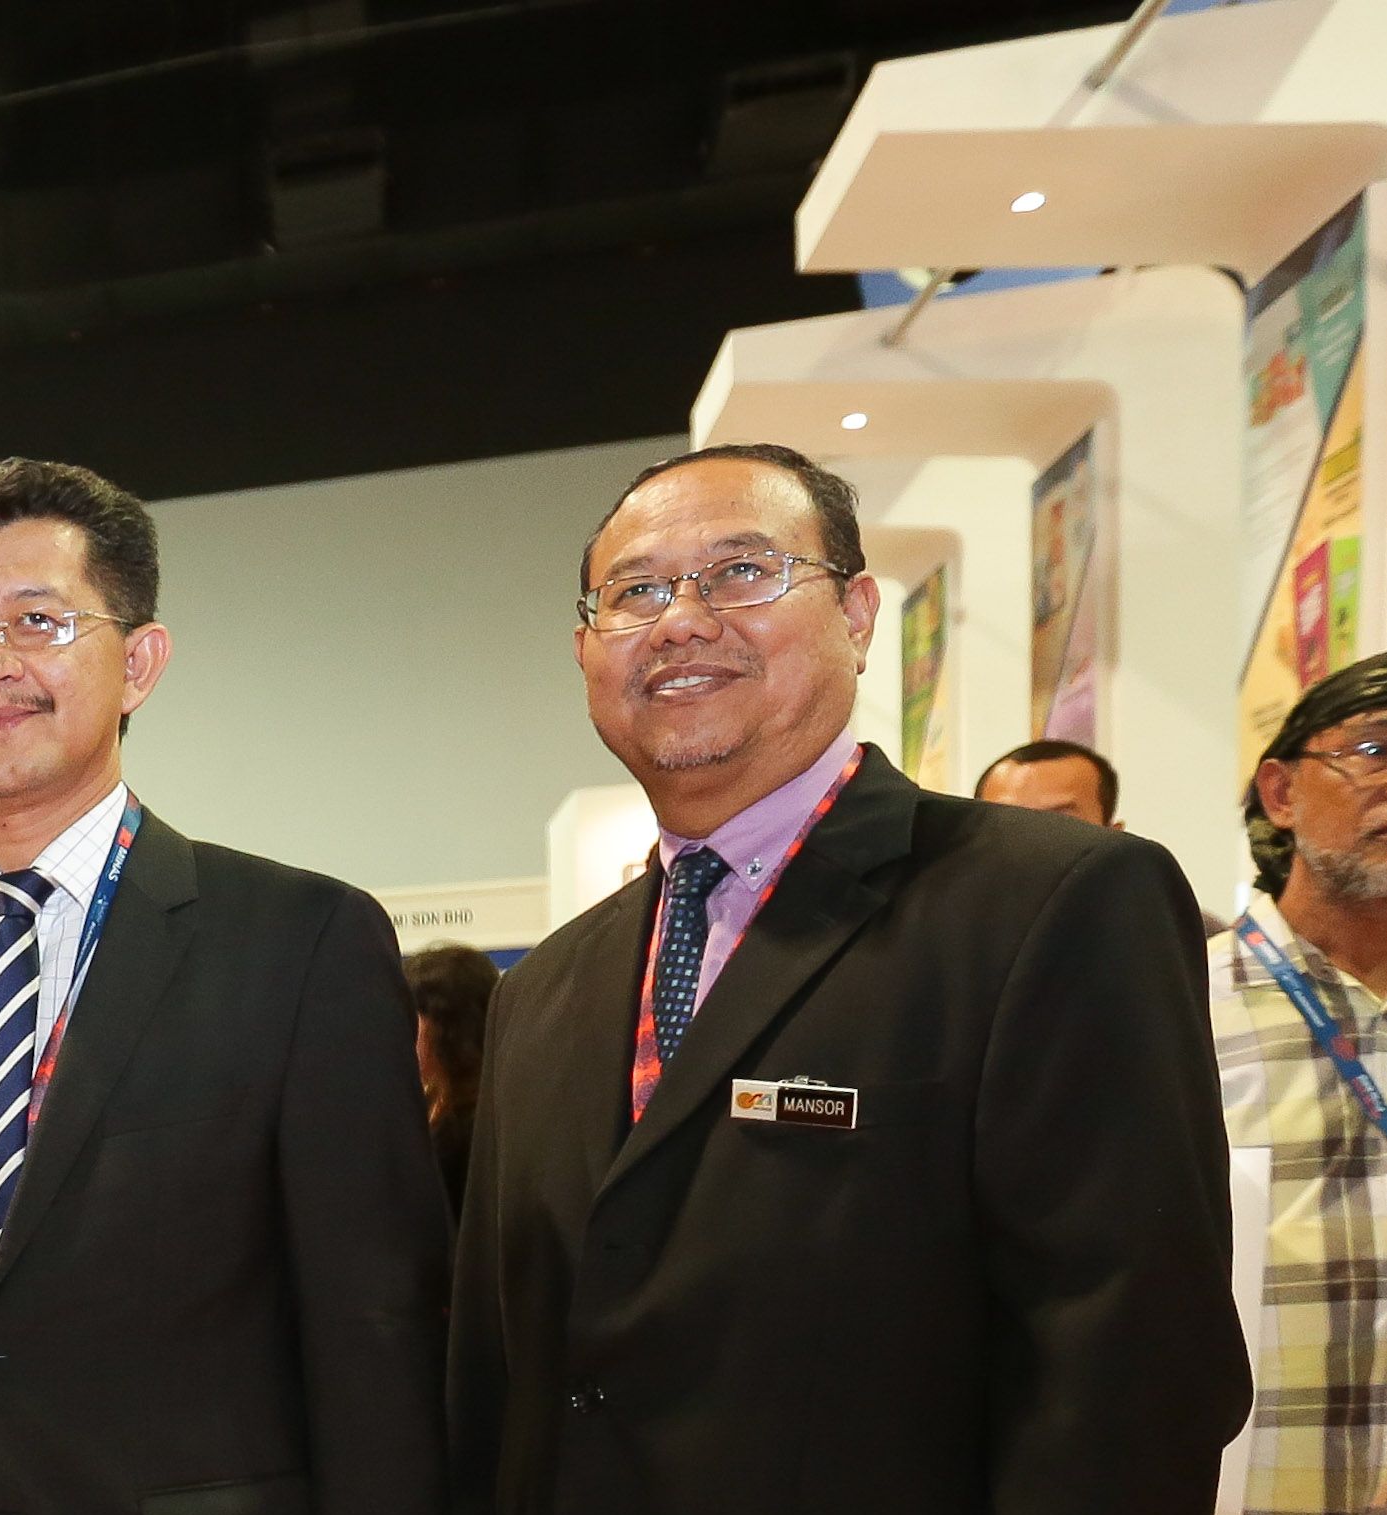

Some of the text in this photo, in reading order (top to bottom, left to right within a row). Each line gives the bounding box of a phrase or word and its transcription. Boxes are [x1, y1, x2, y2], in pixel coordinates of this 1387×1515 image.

[412, 911, 440, 927] SDN
[444, 908, 474, 925] BHD
[783, 1096, 845, 1116] MANSOR
